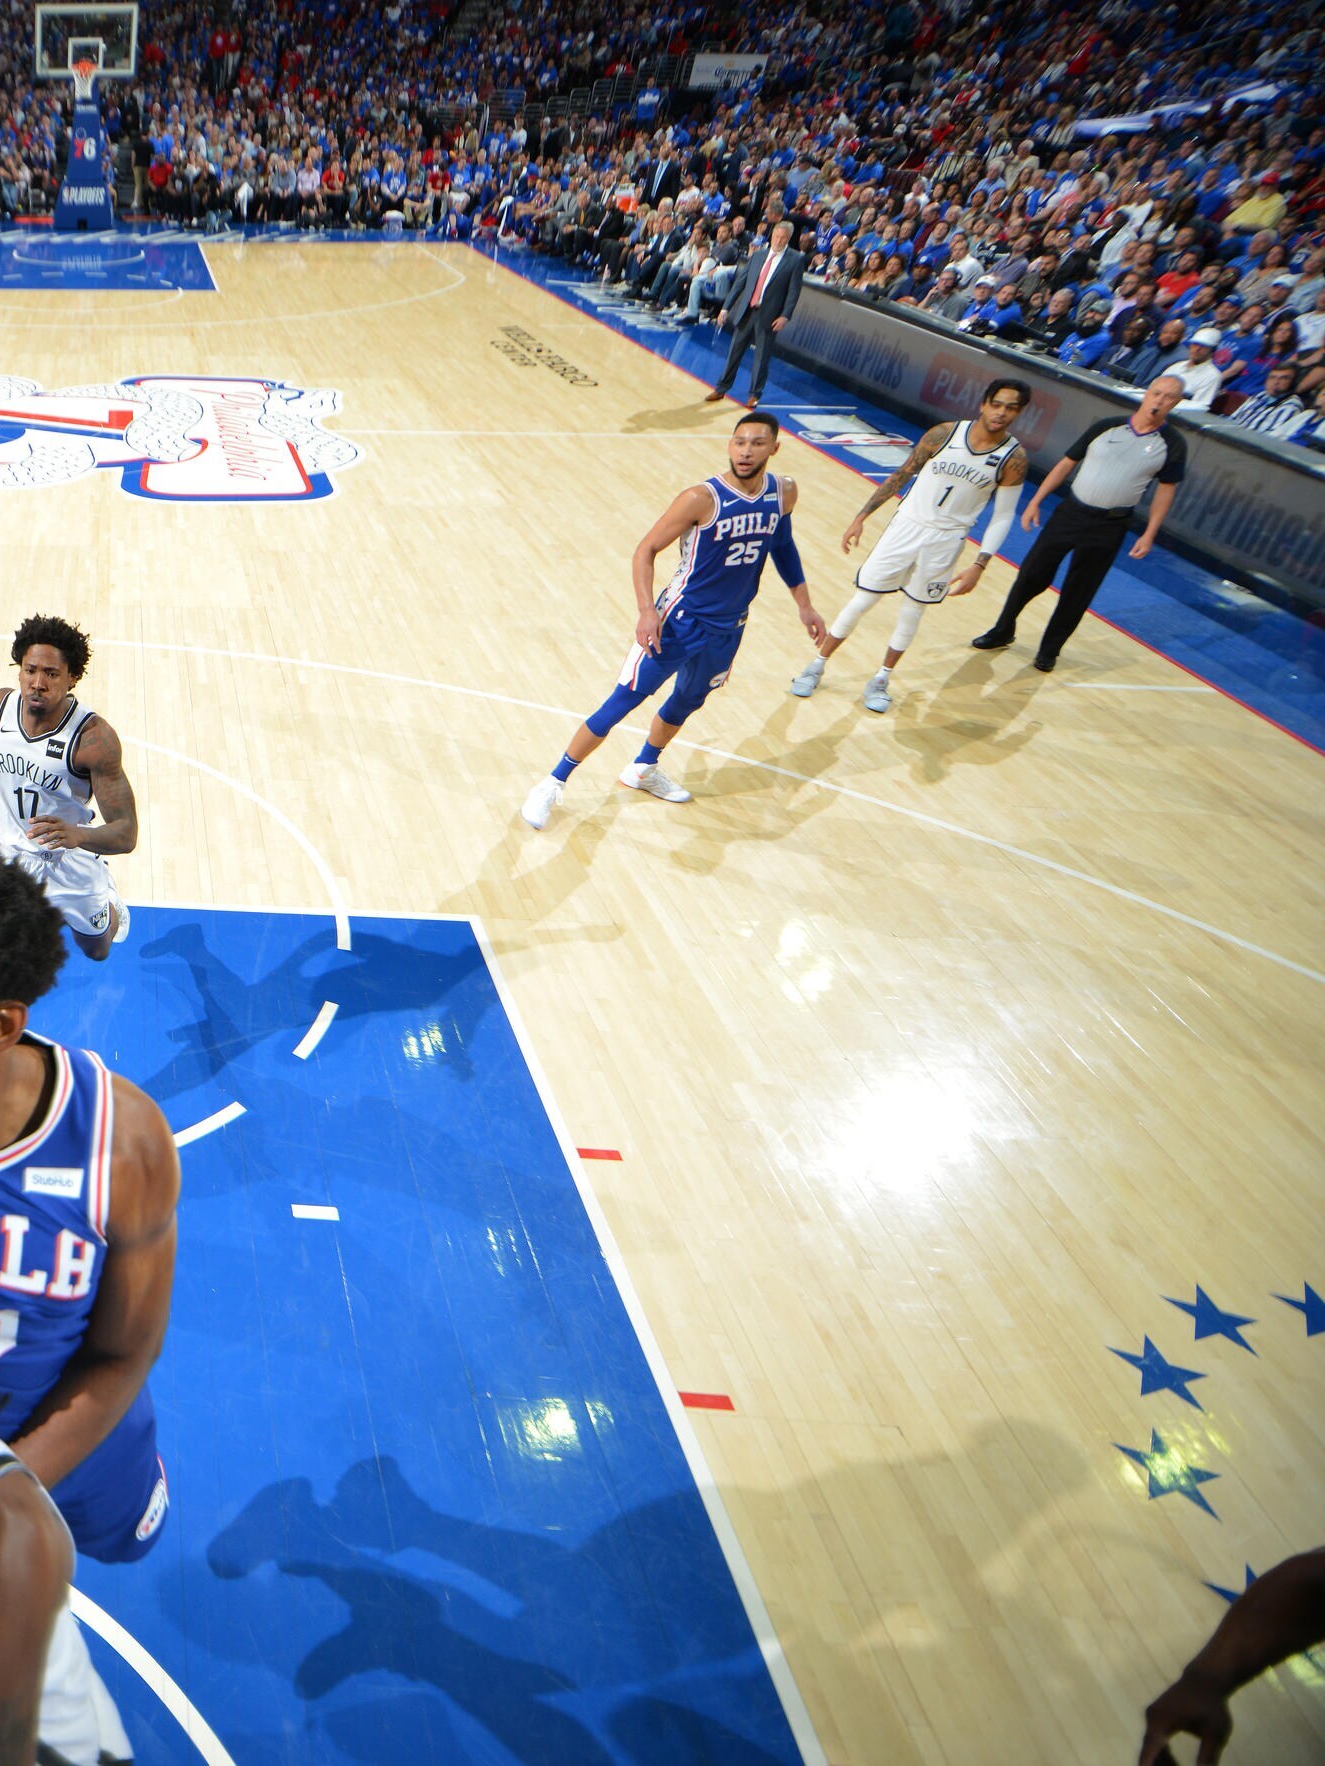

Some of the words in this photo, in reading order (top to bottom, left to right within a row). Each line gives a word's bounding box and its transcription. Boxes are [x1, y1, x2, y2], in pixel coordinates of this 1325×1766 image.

[74, 137, 97, 160] 76
[69, 186, 106, 205] PLAYOFFS
[937, 485, 955, 507] 1
[713, 511, 779, 541] PHILA
[724, 540, 763, 567] 25
[47, 743, 64, 754] infor
[13, 786, 39, 820] 17
[32, 1173, 75, 1189] StubHub
